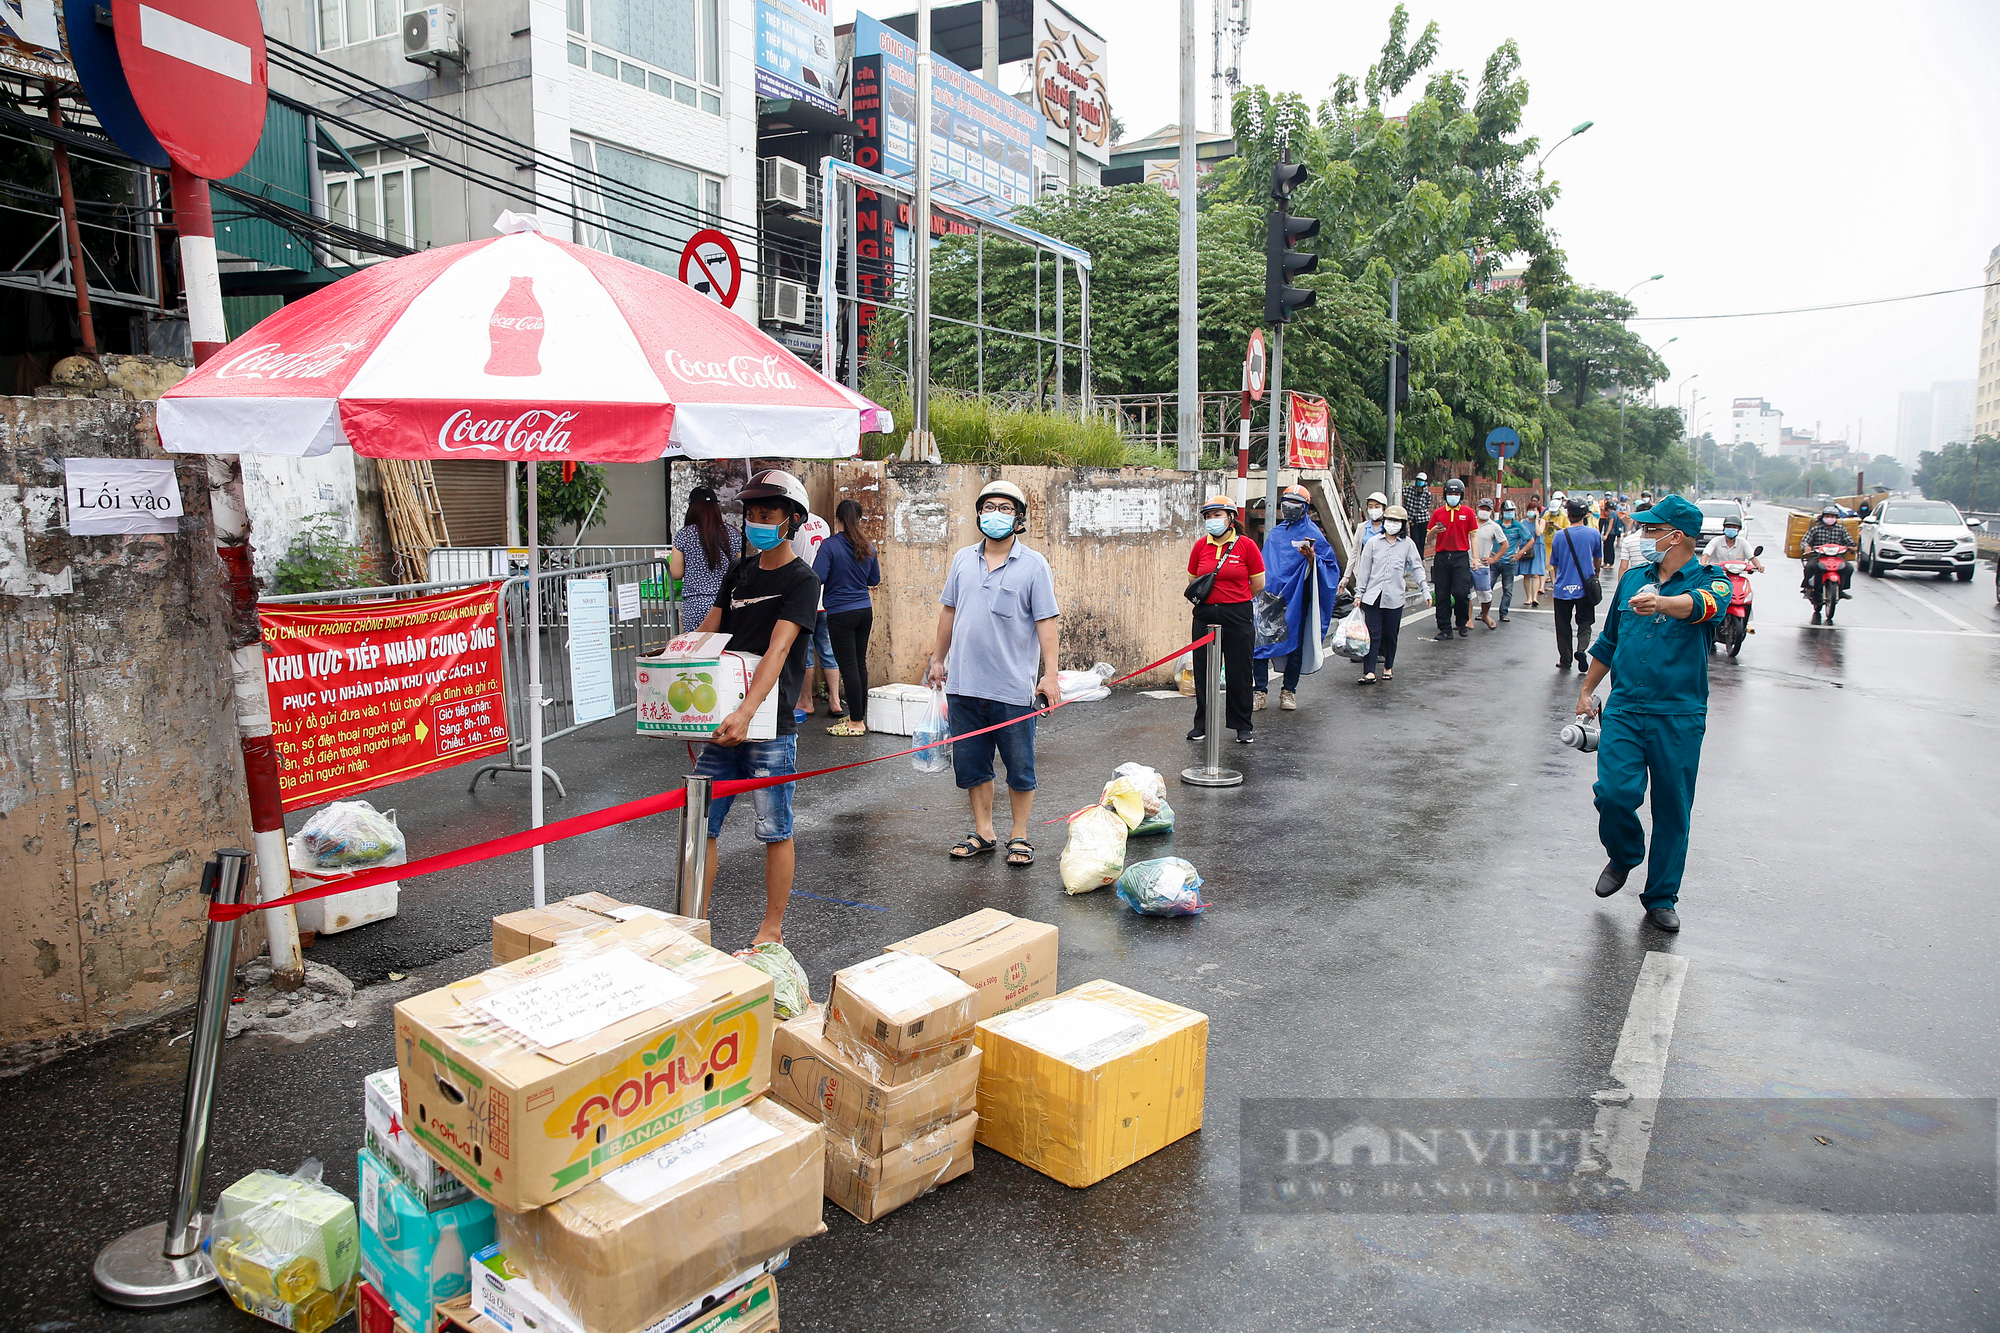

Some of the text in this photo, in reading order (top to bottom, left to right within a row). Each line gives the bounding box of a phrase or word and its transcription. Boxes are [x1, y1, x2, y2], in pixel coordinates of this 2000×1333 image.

[880, 32, 903, 60] CÔNG
[904, 45, 916, 65] TY
[856, 66, 875, 80] CỬA
[948, 70, 962, 90] KHÍ
[1057, 60, 1089, 91] NHÀ HÀNG
[854, 83, 878, 97] HÀNG
[853, 98, 880, 111] JAPAN
[665, 349, 803, 390] Coca-Cola
[437, 408, 580, 454] Coca-Cola
[77, 482, 171, 510] Lối vào
[280, 621, 297, 640] CHỈ
[298, 625, 318, 638] HUY
[318, 620, 353, 636] PHÒNG
[353, 612, 383, 633] CHỐNG
[384, 616, 405, 632] DỊCH
[405, 611, 438, 627] COVID-19
[438, 606, 459, 623] QUẬN
[459, 603, 478, 618] HOÀN
[267, 624, 496, 683] KHU VỰC TIẾP NHẬN CUNG ỨNG
[283, 661, 487, 712] PHỤC VỤ NHÂN DÂN KHU VỰC CÁCH LY
[271, 717, 292, 736] Chú
[295, 716, 303, 734] ý
[306, 711, 318, 729] đồ
[319, 711, 337, 729] gửi
[339, 708, 361, 723] đưa
[362, 704, 380, 716] vào
[382, 701, 387, 713] 1
[389, 697, 401, 712] túi
[403, 696, 422, 709] cho
[424, 693, 429, 704] 1
[429, 691, 442, 706] gia
[443, 686, 461, 700] đình
[463, 684, 473, 695] và
[475, 680, 486, 696] ghi
[438, 700, 492, 721] Giờ tiếp nhận:
[276, 718, 406, 754] Tên, số điện thoại người gửi
[439, 715, 490, 737] Sáng: 8h-10h
[440, 735, 466, 751] Chiều:
[468, 730, 482, 743] 14h
[488, 726, 505, 739] 16h
[303, 750, 315, 767] số
[317, 749, 340, 766] điện
[340, 742, 362, 756] thoại
[363, 737, 390, 754] người
[391, 733, 412, 746] nhận
[279, 775, 297, 790] Địa
[299, 767, 314, 783] chỉ
[315, 764, 346, 782] người
[525, 964, 546, 977] NOT
[986, 975, 998, 987] 500g
[1014, 991, 1040, 1008] NUTRITION
[500, 1134, 508, 1142] 11
[609, 1100, 704, 1156] BANANAS
[491, 1140, 499, 1149] 12
[660, 1322, 671, 1331] Men
